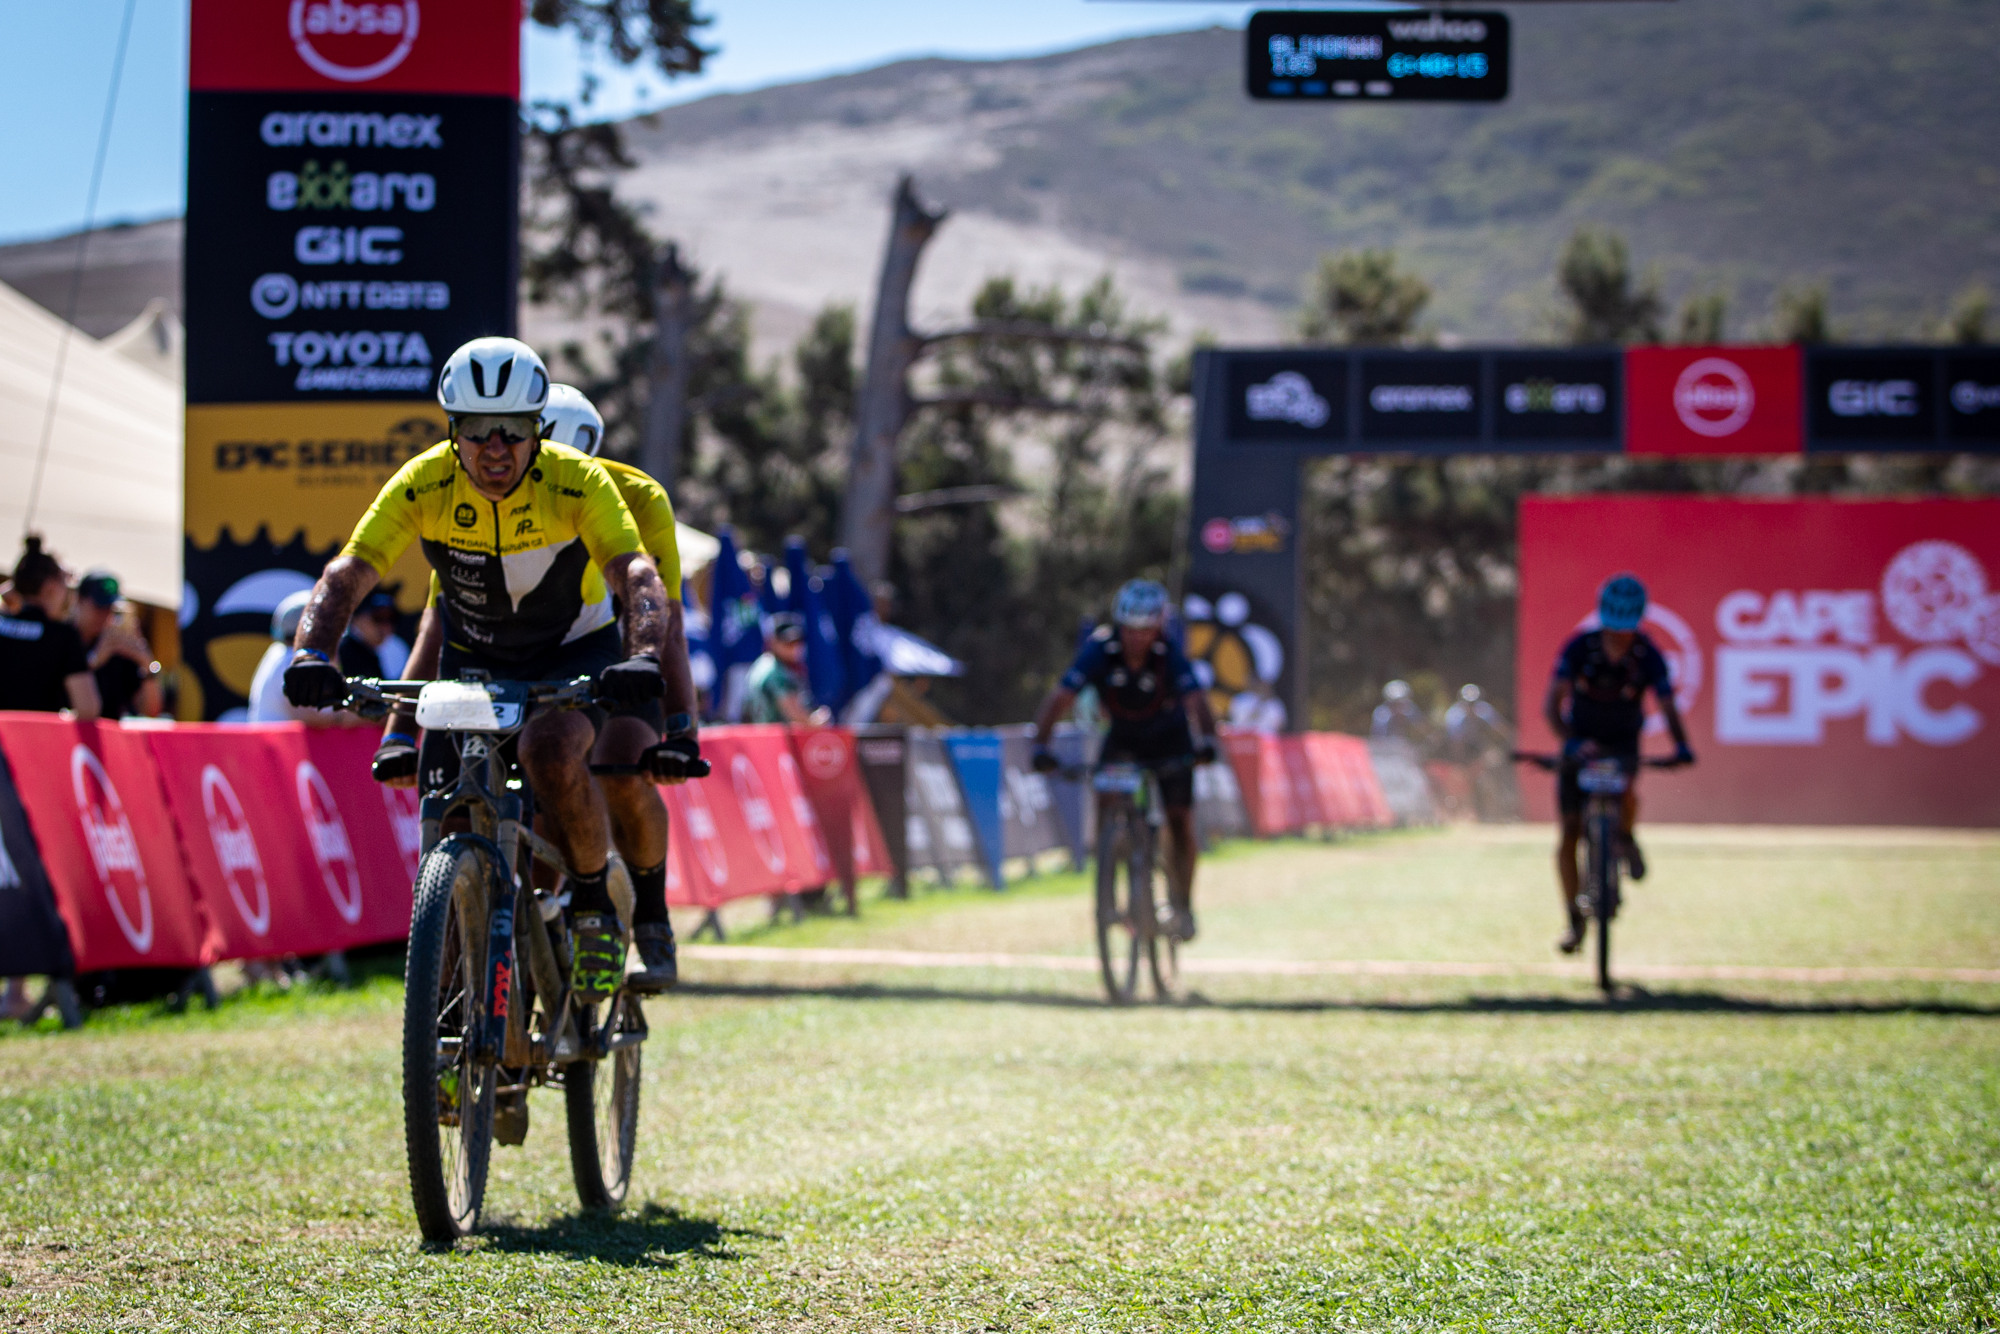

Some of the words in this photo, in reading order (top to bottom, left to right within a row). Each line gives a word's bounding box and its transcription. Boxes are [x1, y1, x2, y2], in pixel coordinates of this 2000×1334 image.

[304, 0, 404, 35] absa
[260, 112, 443, 147] aramex
[266, 160, 436, 211] exxaro
[294, 226, 404, 264] GIC
[268, 331, 432, 367] TOYOTA
[1715, 590, 1876, 643] CAPE
[1714, 645, 1982, 747] EPIC
